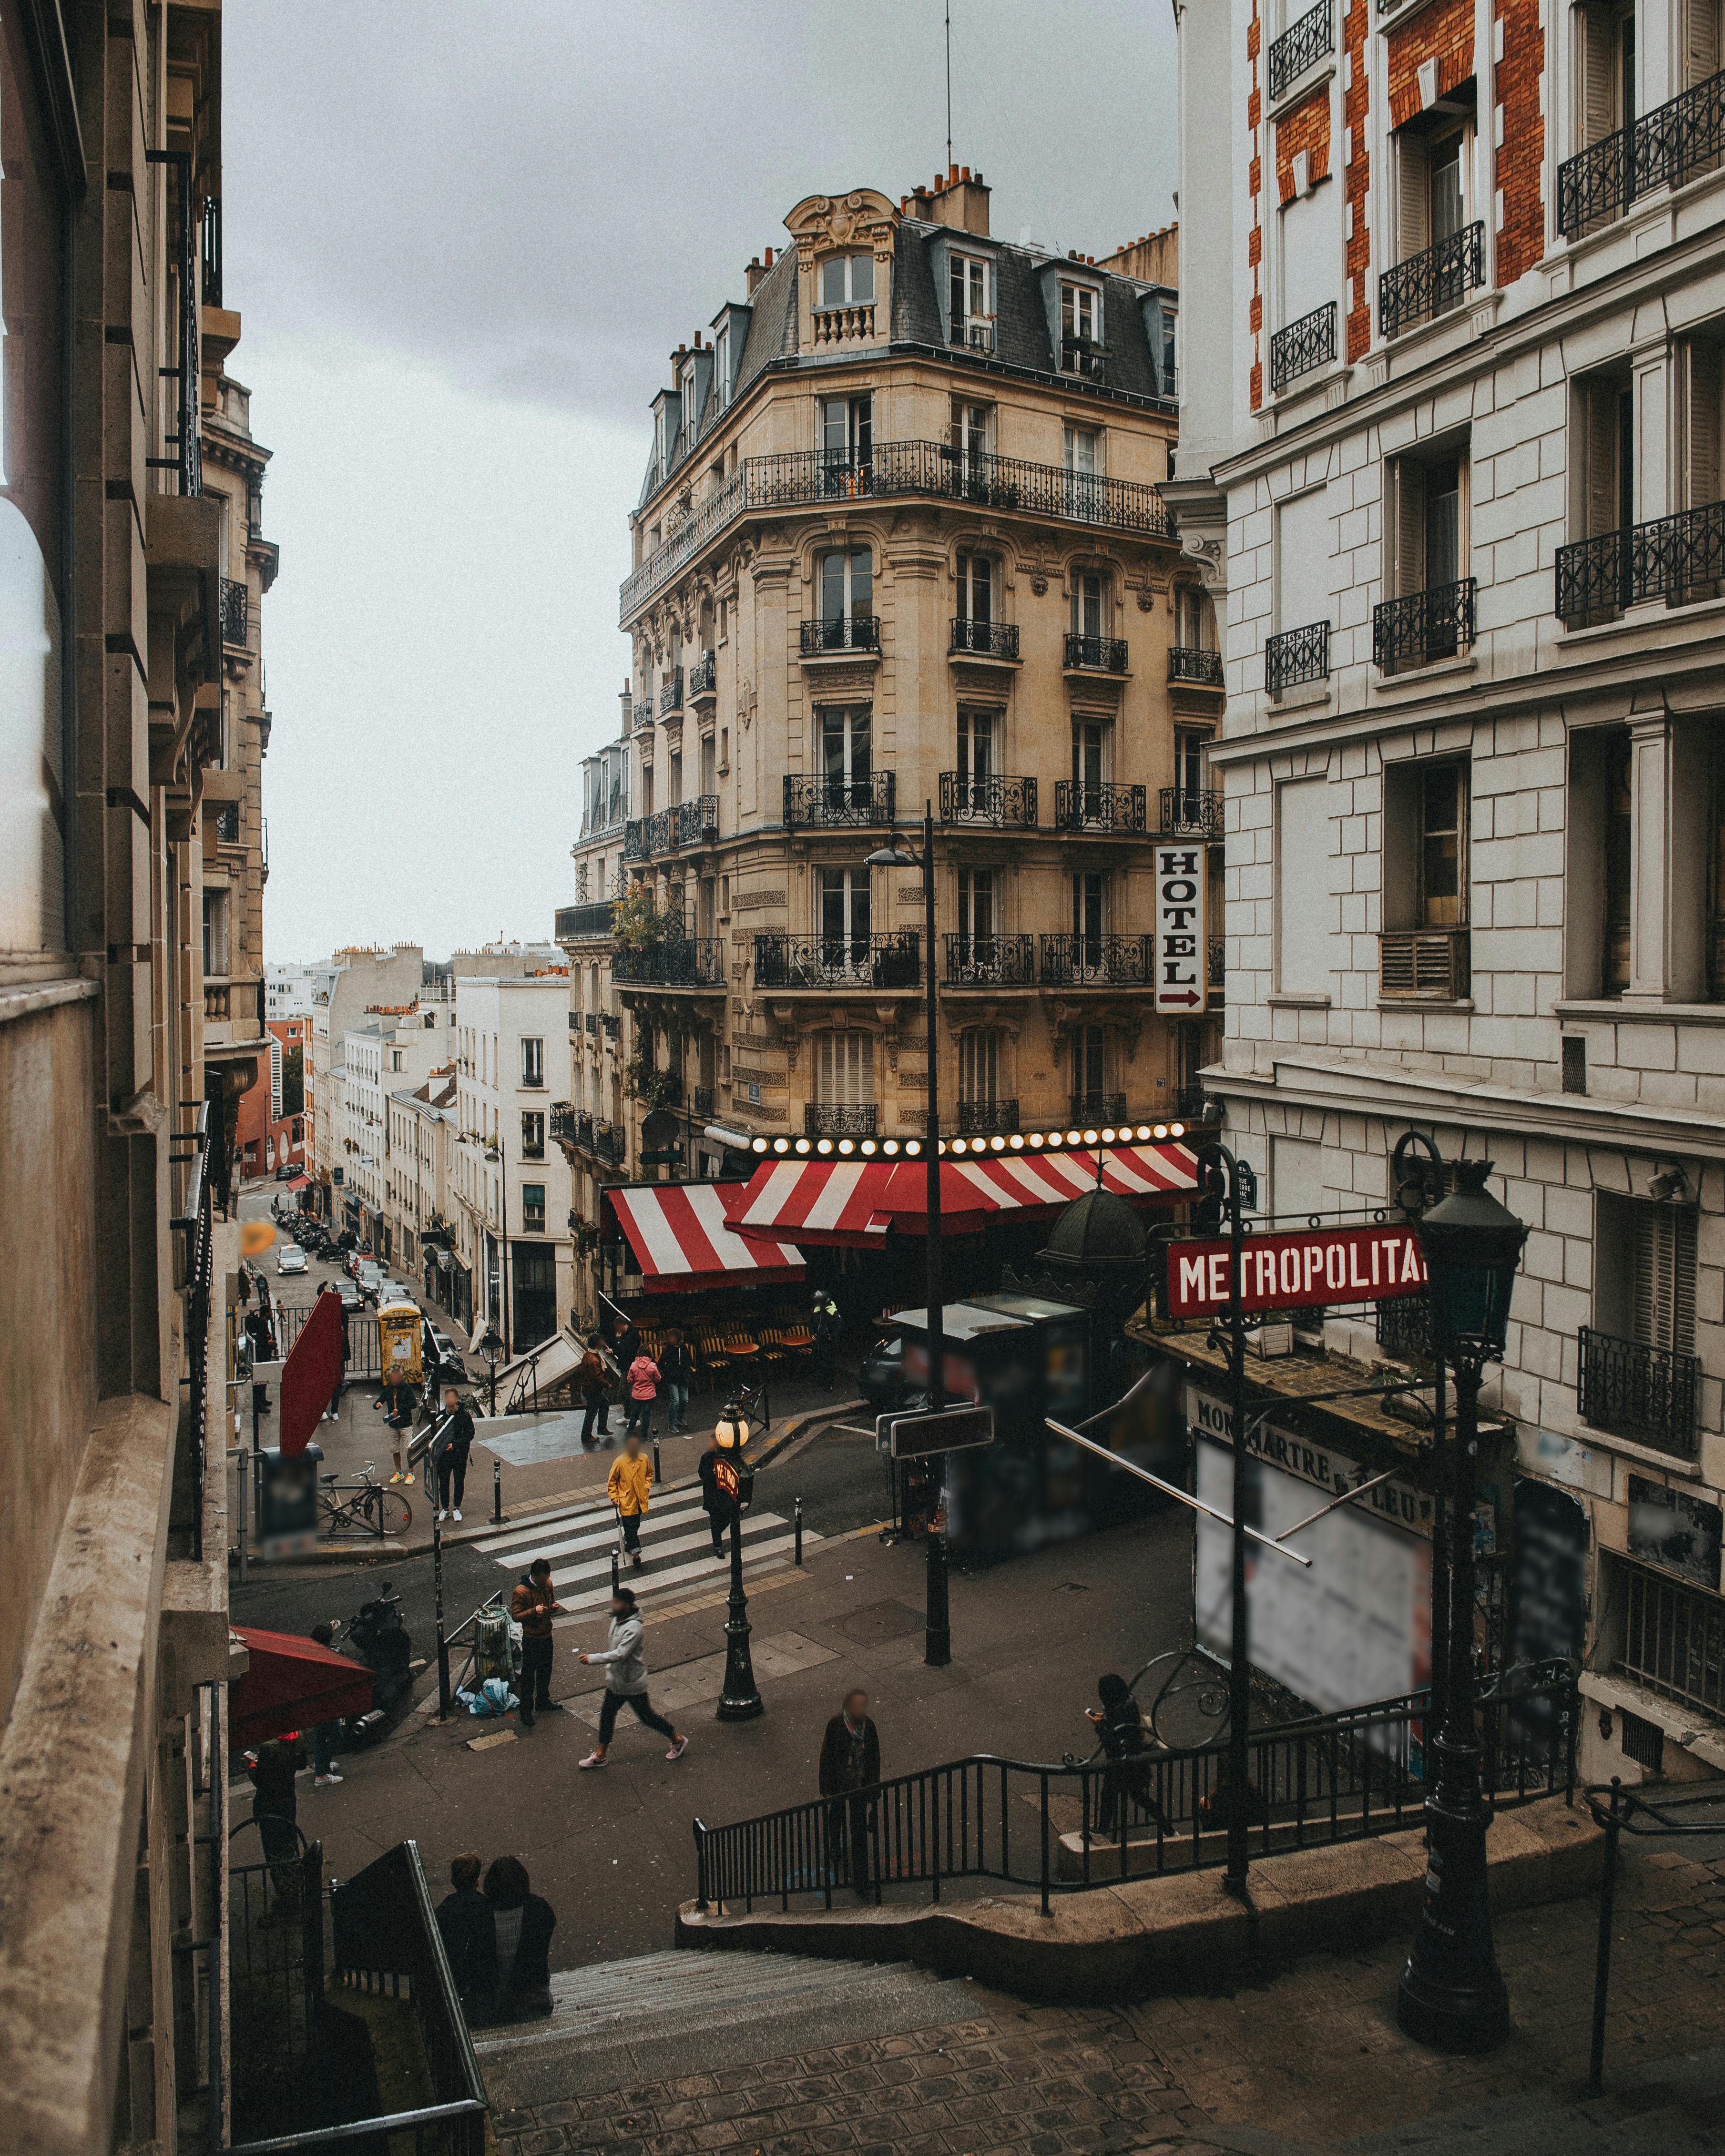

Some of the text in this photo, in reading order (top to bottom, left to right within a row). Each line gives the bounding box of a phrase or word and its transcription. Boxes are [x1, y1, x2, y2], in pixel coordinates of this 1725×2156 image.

[1160, 852, 1198, 985] HOTEL
[1179, 1238, 1429, 1303] METROPOLITA
[716, 1464, 735, 1489] METRO
